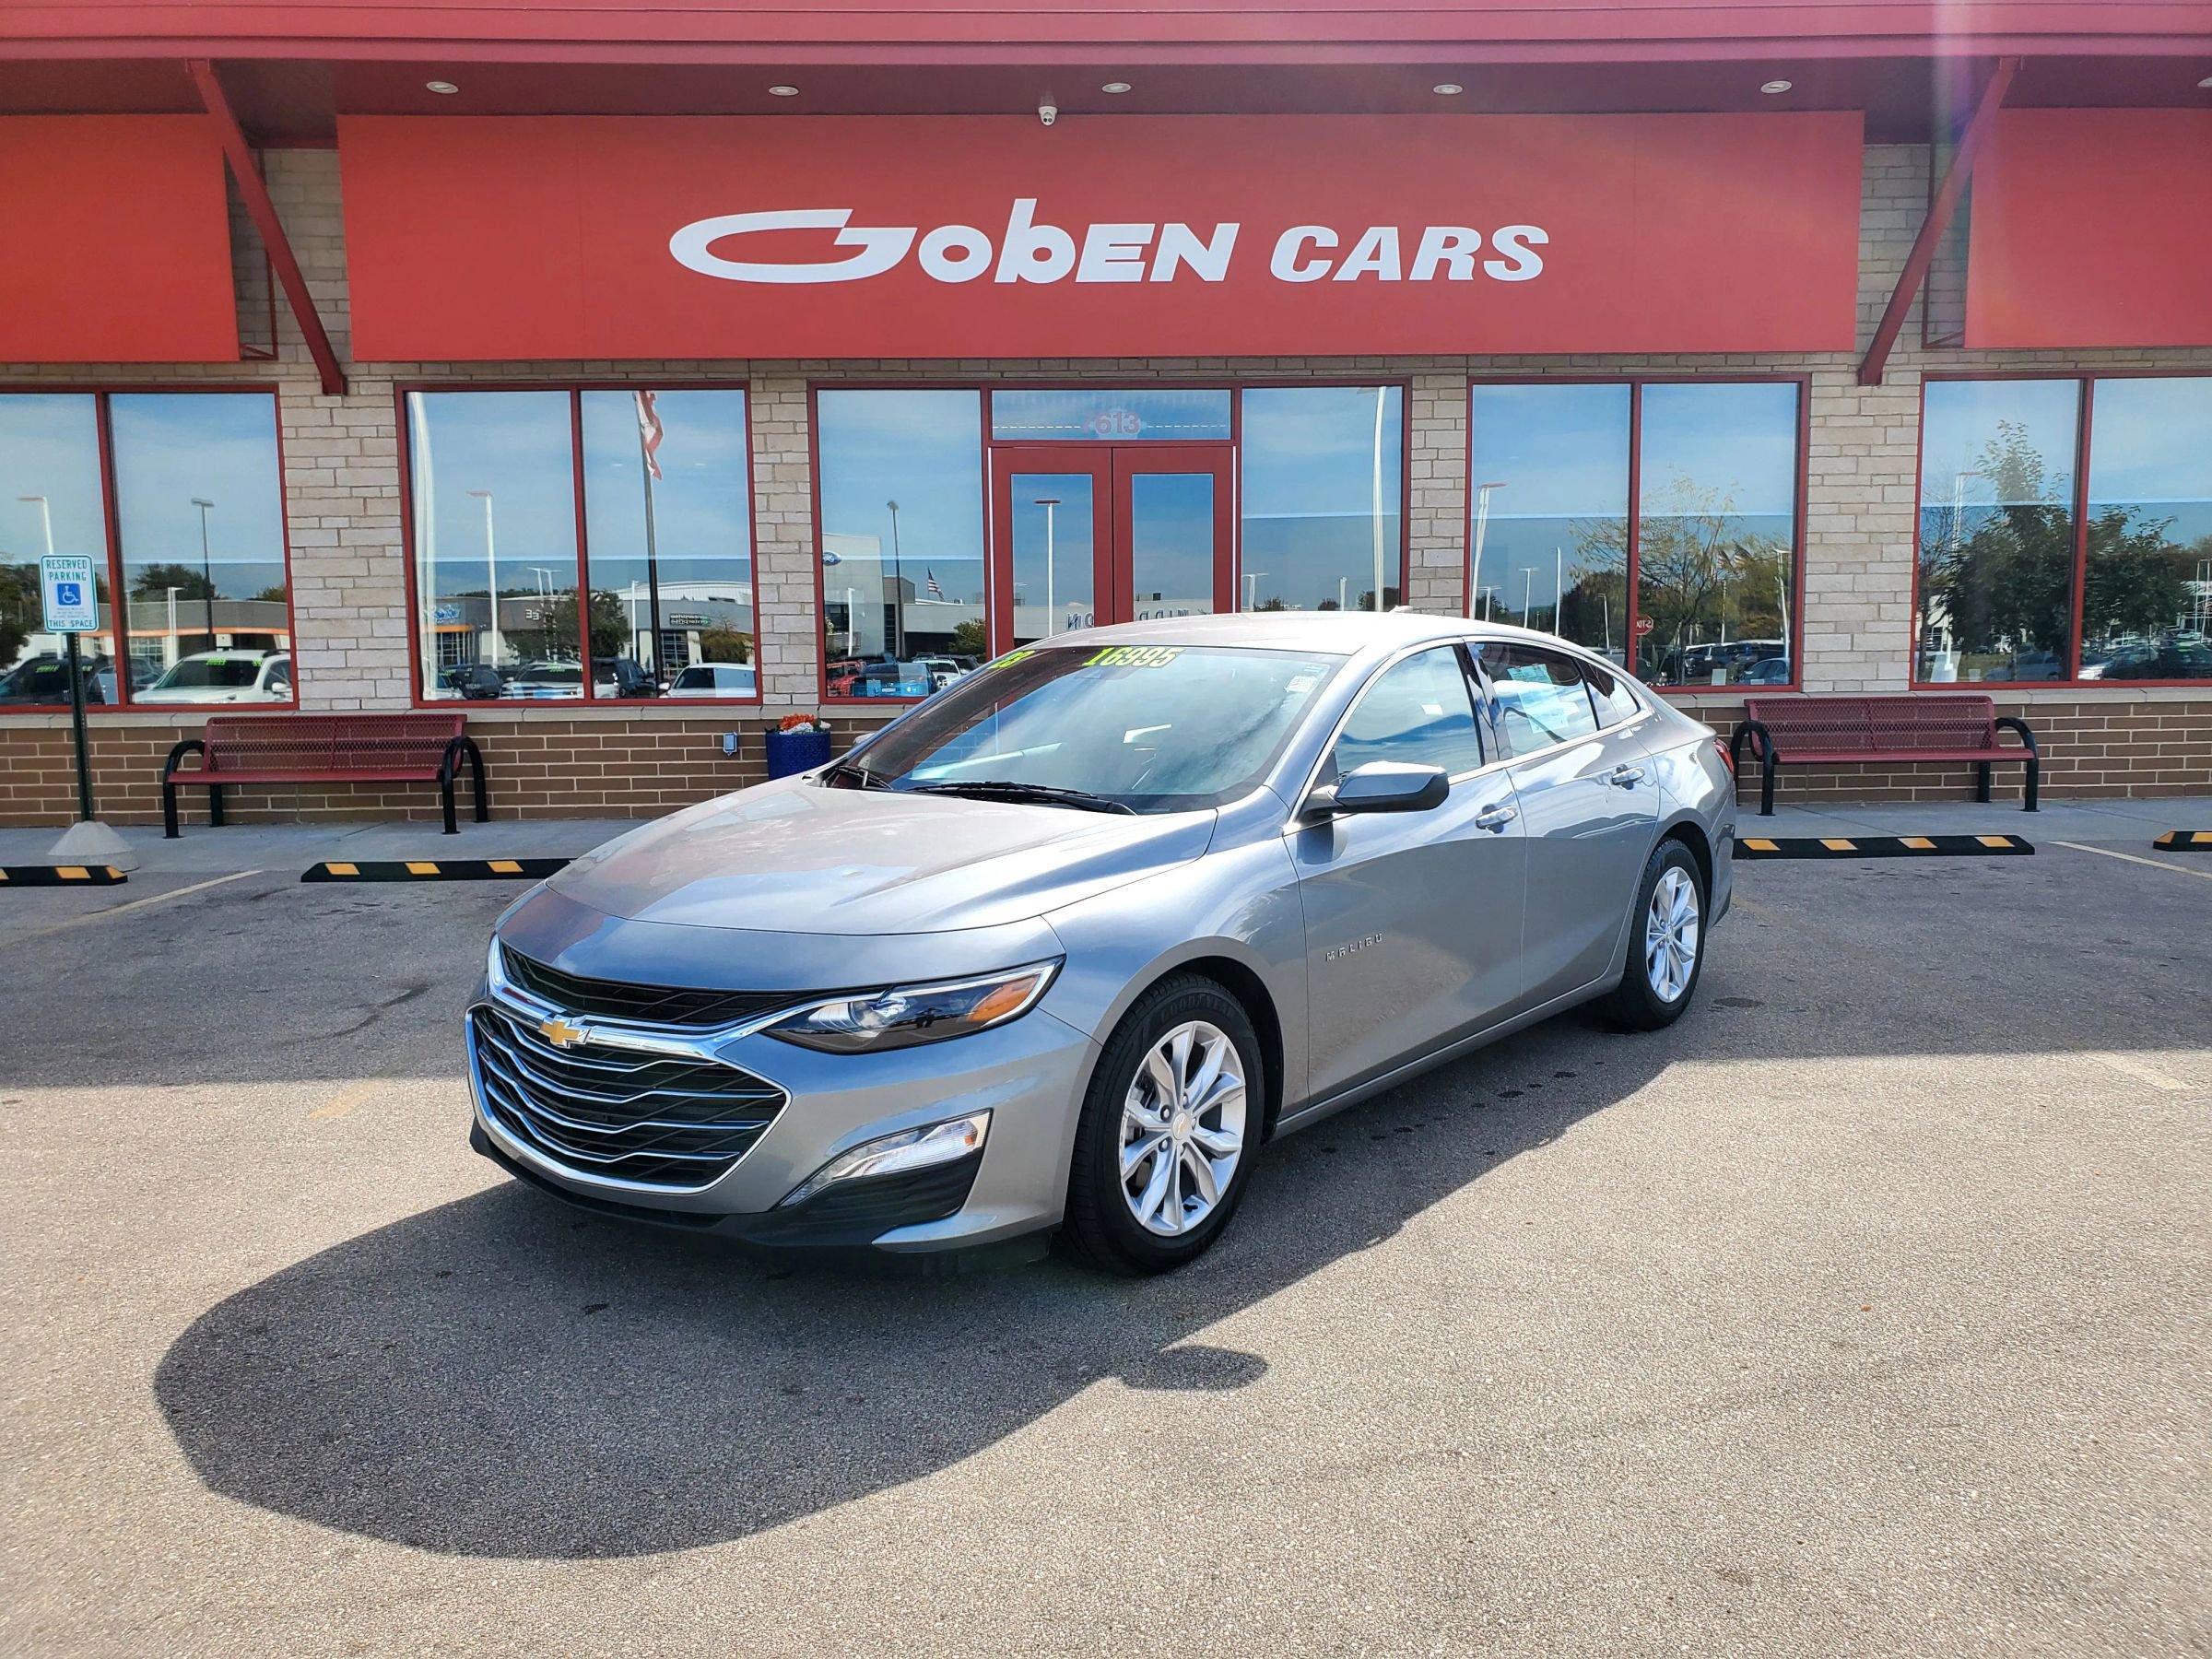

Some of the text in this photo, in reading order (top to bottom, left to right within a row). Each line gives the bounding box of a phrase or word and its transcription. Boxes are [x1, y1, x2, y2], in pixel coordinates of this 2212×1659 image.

[1269, 224, 1550, 283] CARS
[46, 559, 88, 570] RESERVED
[49, 571, 87, 582] PARKING
[48, 619, 94, 628] THIS SPACE
[1082, 647, 1186, 667] 16995
[1325, 933, 1382, 961] MALIBU
